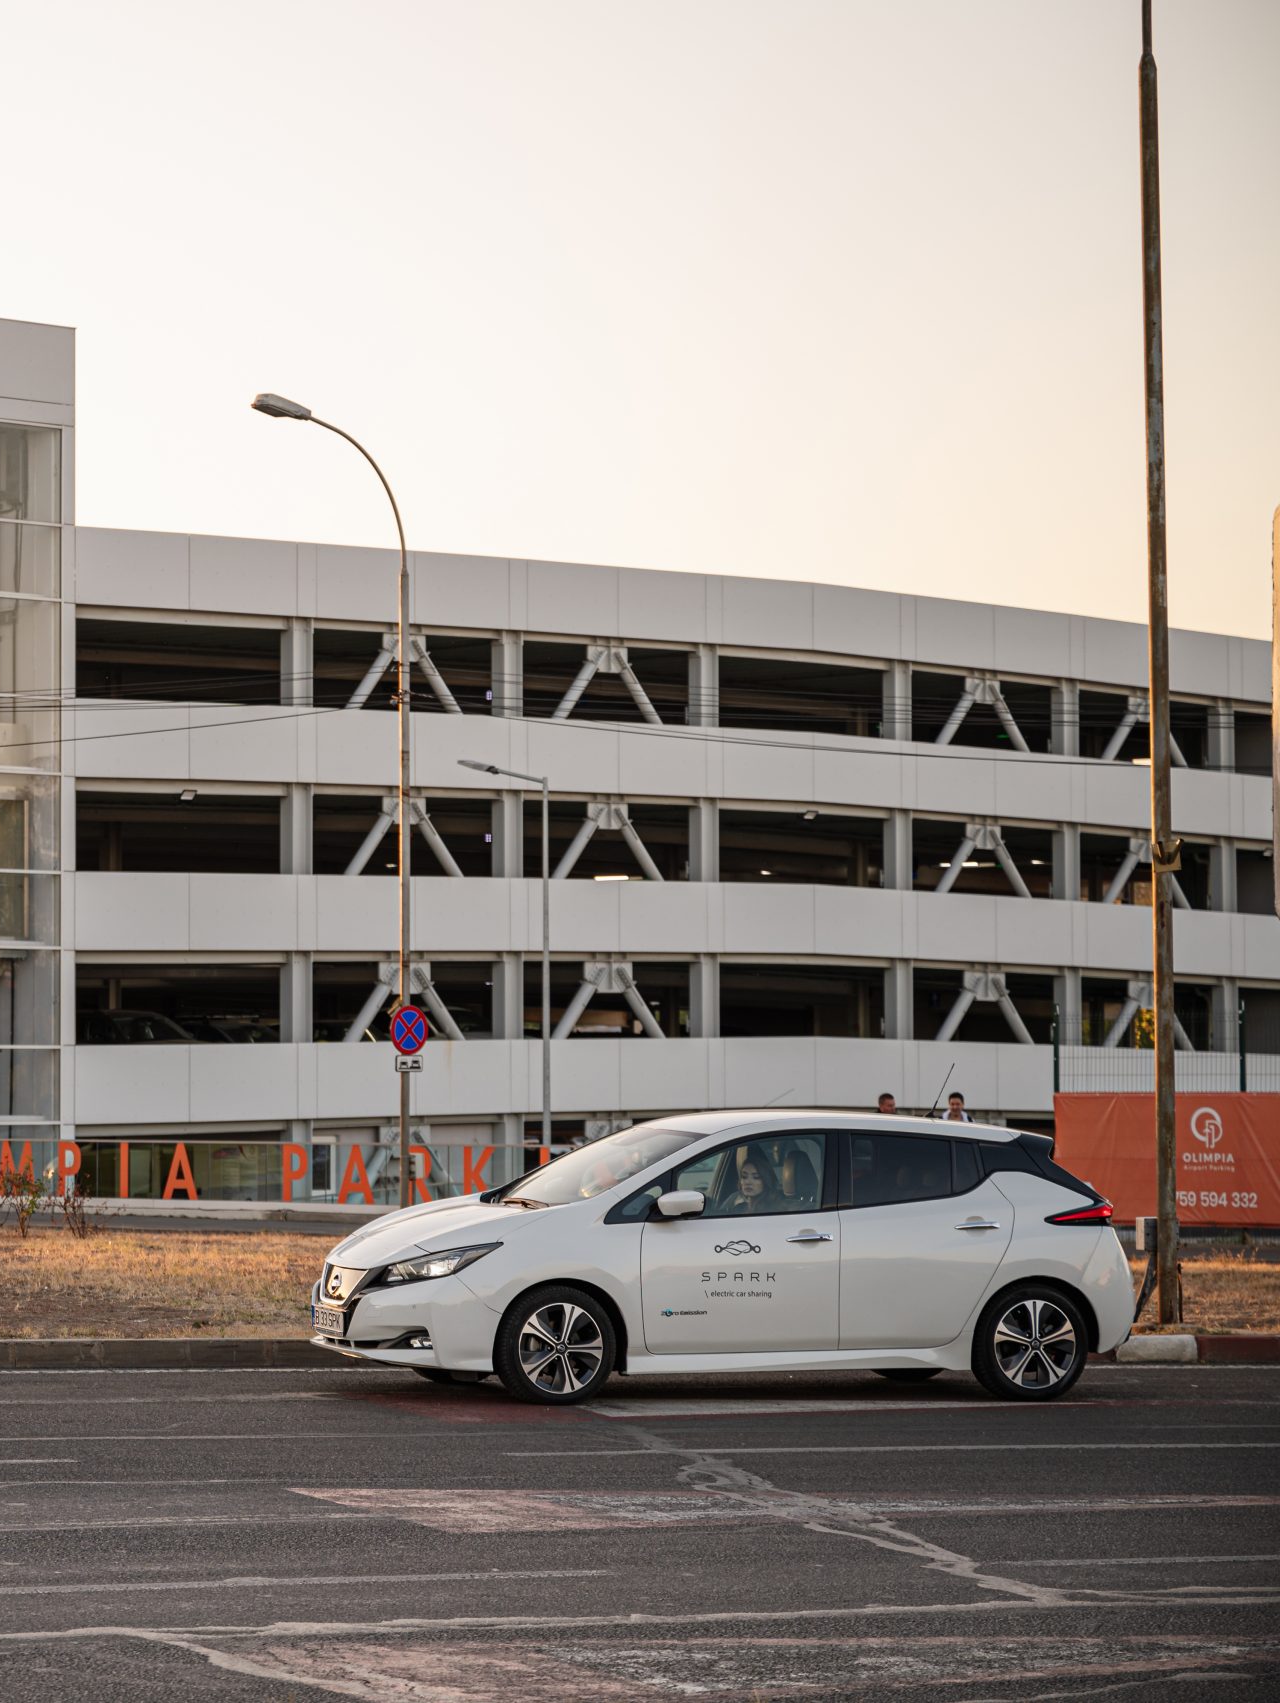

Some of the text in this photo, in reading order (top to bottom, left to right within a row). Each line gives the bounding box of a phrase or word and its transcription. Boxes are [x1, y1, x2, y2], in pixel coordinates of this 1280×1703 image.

[1182, 1152, 1234, 1163] OLIMPIA
[1183, 1164, 1235, 1172] Airport Parking
[1200, 1190, 1228, 1208] 594
[1231, 1192, 1258, 1209] 332
[701, 1271, 776, 1283] SPARK
[710, 1289, 735, 1298] electric
[747, 1290, 772, 1299] sharing
[321, 1310, 328, 1327] 33
[328, 1312, 341, 1329] SPK
